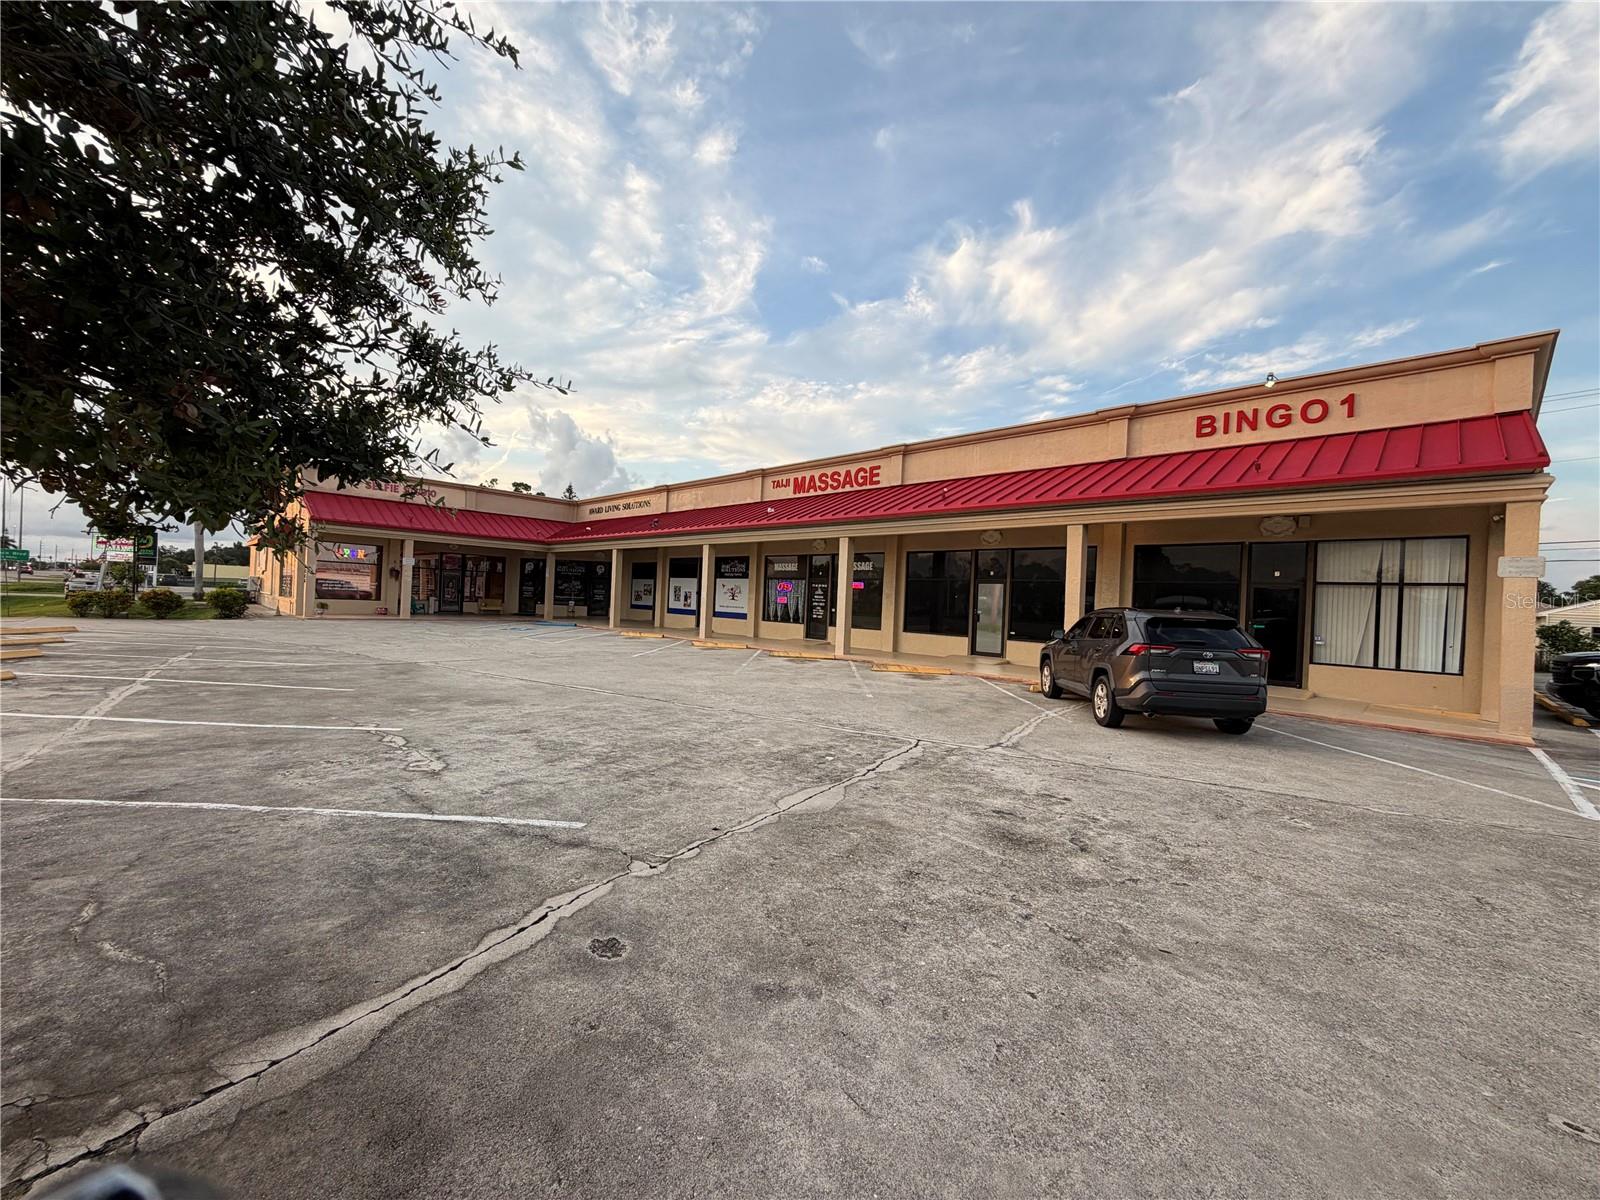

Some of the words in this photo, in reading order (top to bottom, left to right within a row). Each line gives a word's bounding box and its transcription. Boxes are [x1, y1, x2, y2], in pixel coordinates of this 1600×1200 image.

[771, 478, 791, 489] TAIJI
[792, 465, 881, 495] MASSAGE
[604, 504, 621, 513] LIVING
[621, 500, 651, 511] SOLUTIONS
[774, 562, 798, 571] MASSAGE
